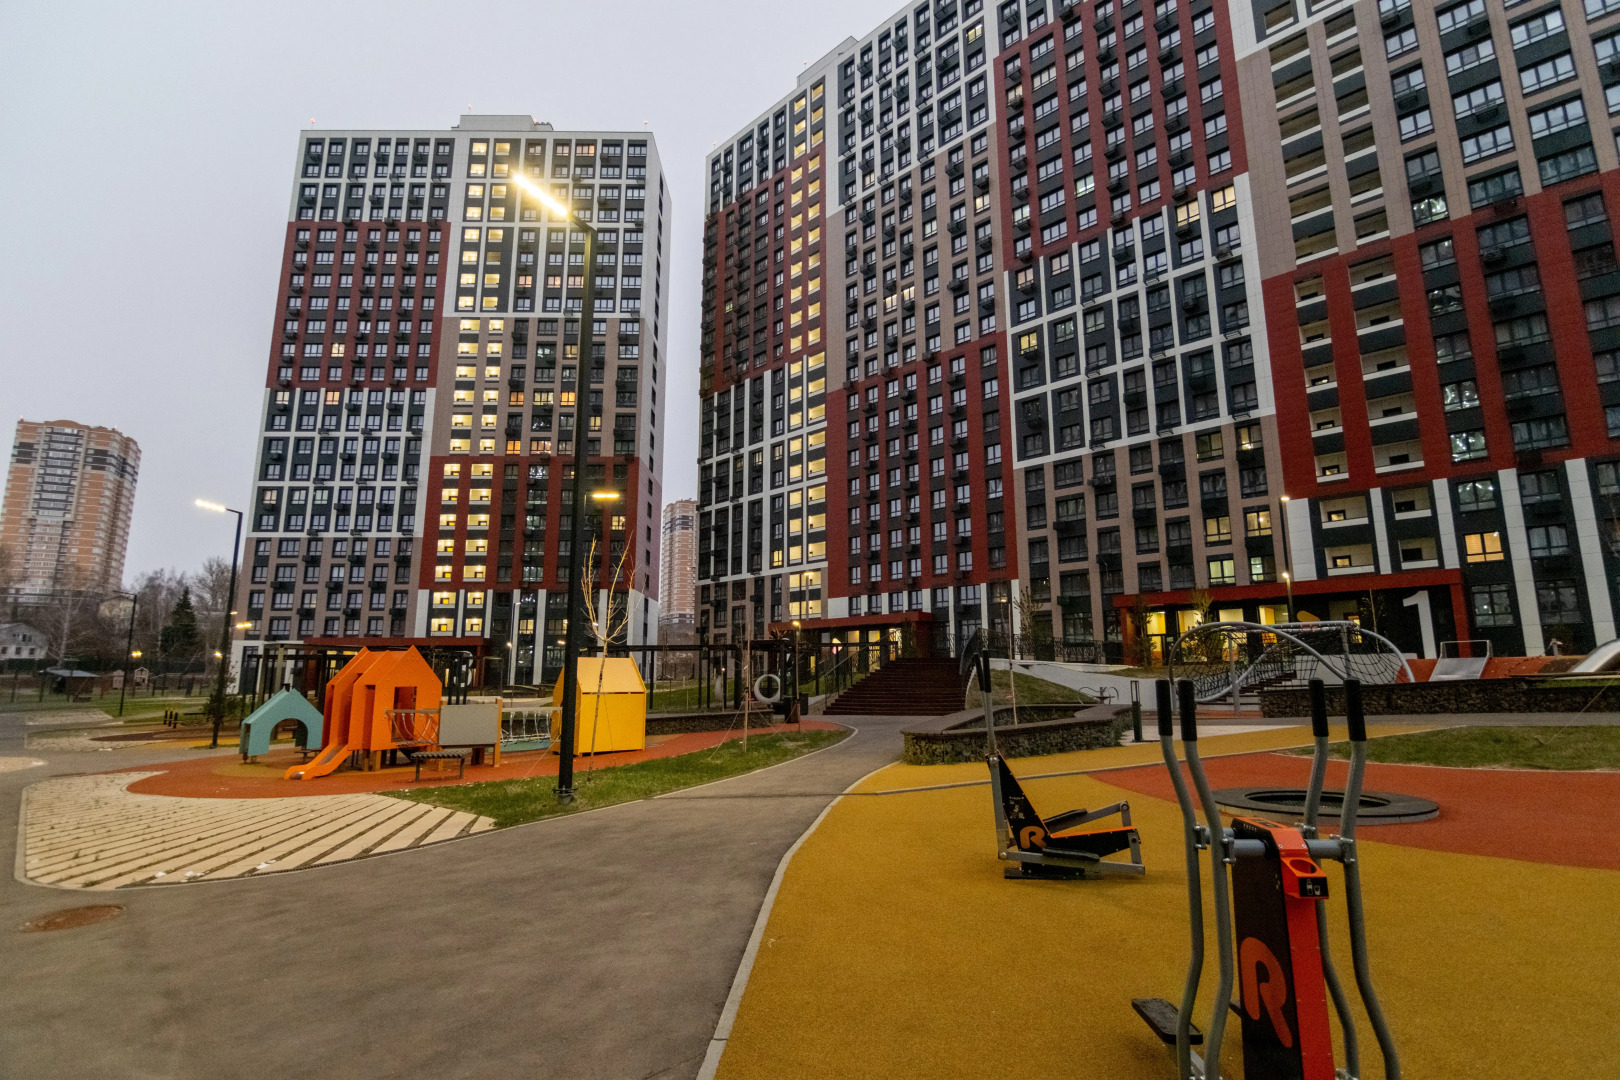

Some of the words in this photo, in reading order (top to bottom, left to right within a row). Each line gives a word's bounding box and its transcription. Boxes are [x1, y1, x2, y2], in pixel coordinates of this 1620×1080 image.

[1402, 589, 1437, 659] 1
[1019, 825, 1047, 849] R
[1240, 937, 1293, 1048] R
